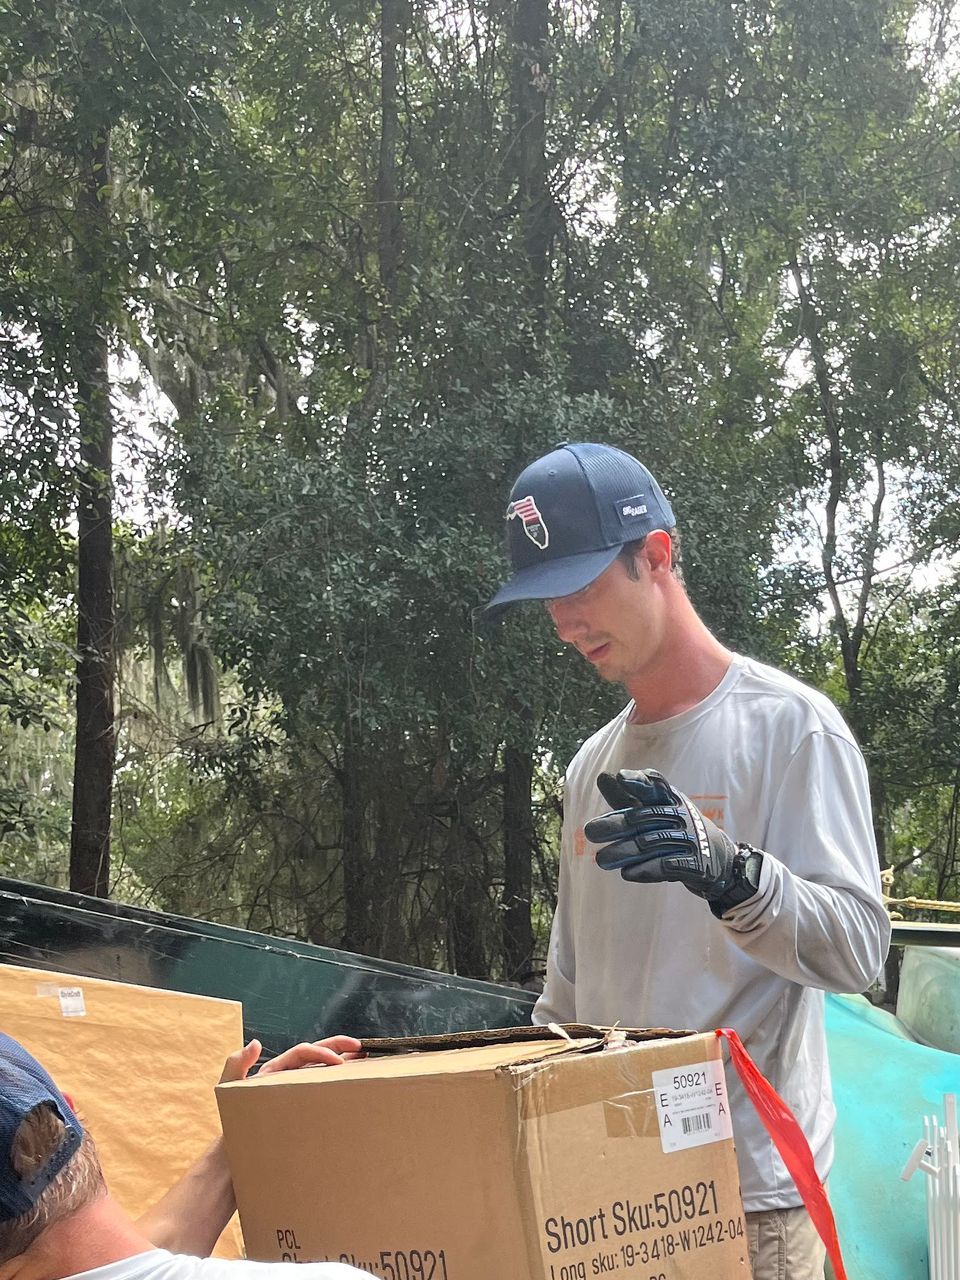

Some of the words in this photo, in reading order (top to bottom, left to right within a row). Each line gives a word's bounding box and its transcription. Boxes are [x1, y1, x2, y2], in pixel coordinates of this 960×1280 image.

[673, 1071, 707, 1090] 50921
[714, 1082, 723, 1096] E
[660, 1093, 669, 1107] E
[718, 1102, 727, 1116] A
[663, 1113, 673, 1128] A
[545, 1208, 608, 1253] Short
[612, 1180, 718, 1236] Sku:50921
[277, 1229, 301, 1250] PCL
